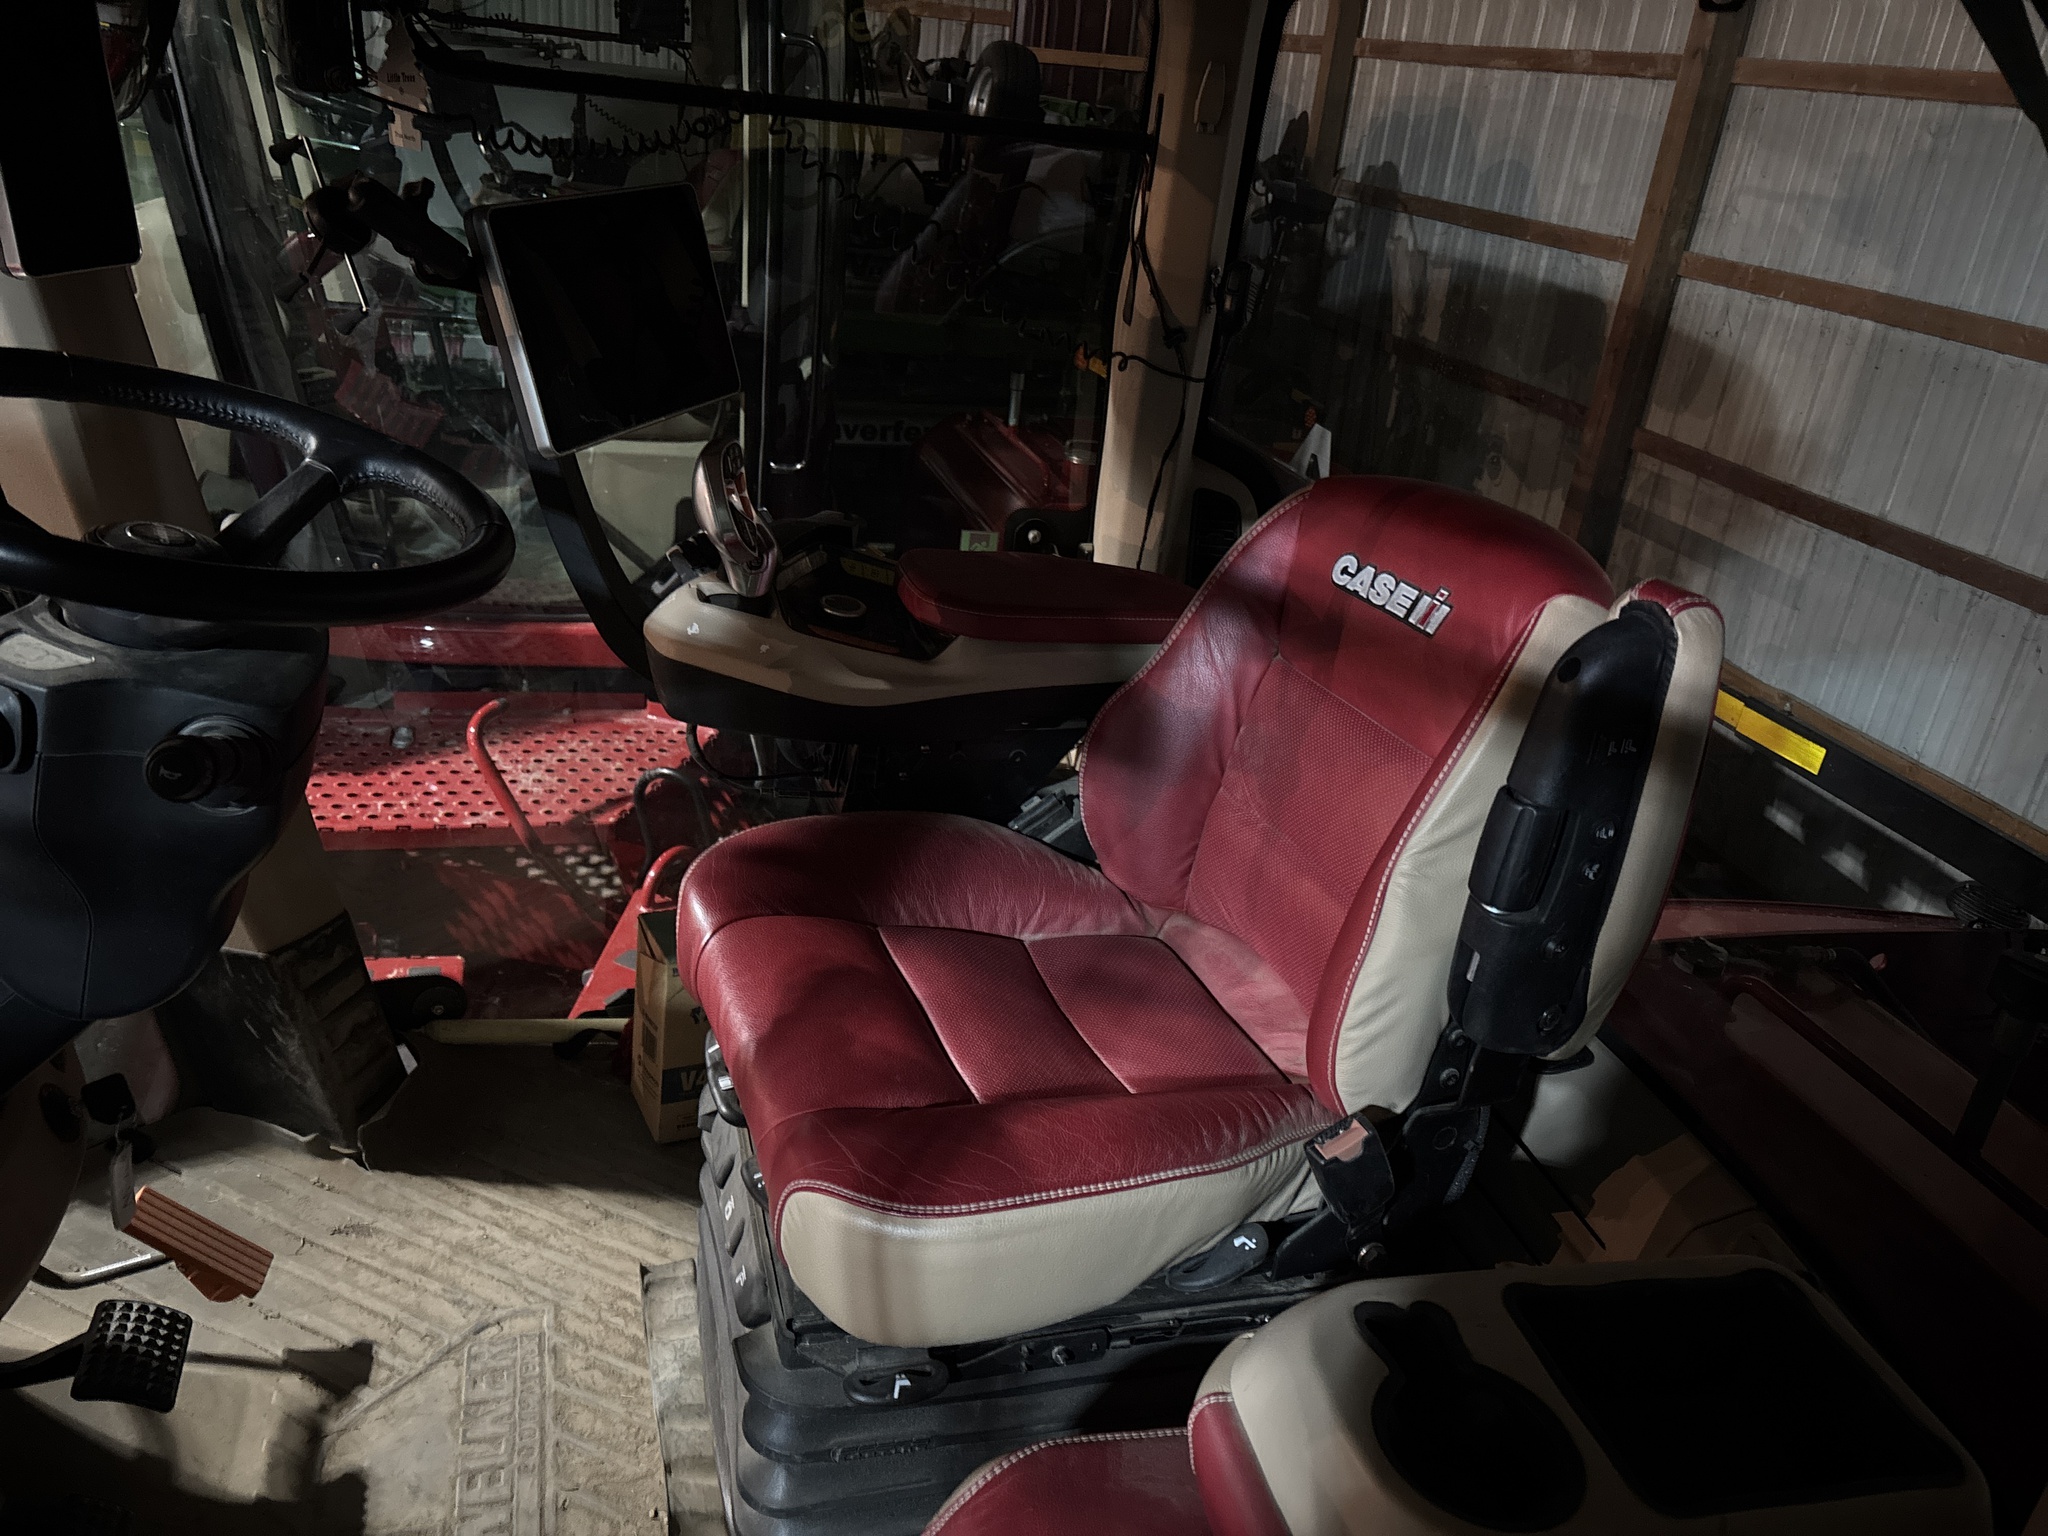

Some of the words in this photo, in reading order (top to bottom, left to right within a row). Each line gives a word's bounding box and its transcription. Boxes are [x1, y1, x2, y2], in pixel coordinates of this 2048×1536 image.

[387, 72, 401, 83] Little
[402, 72, 415, 82] Trees
[1331, 553, 1421, 619] CASE
